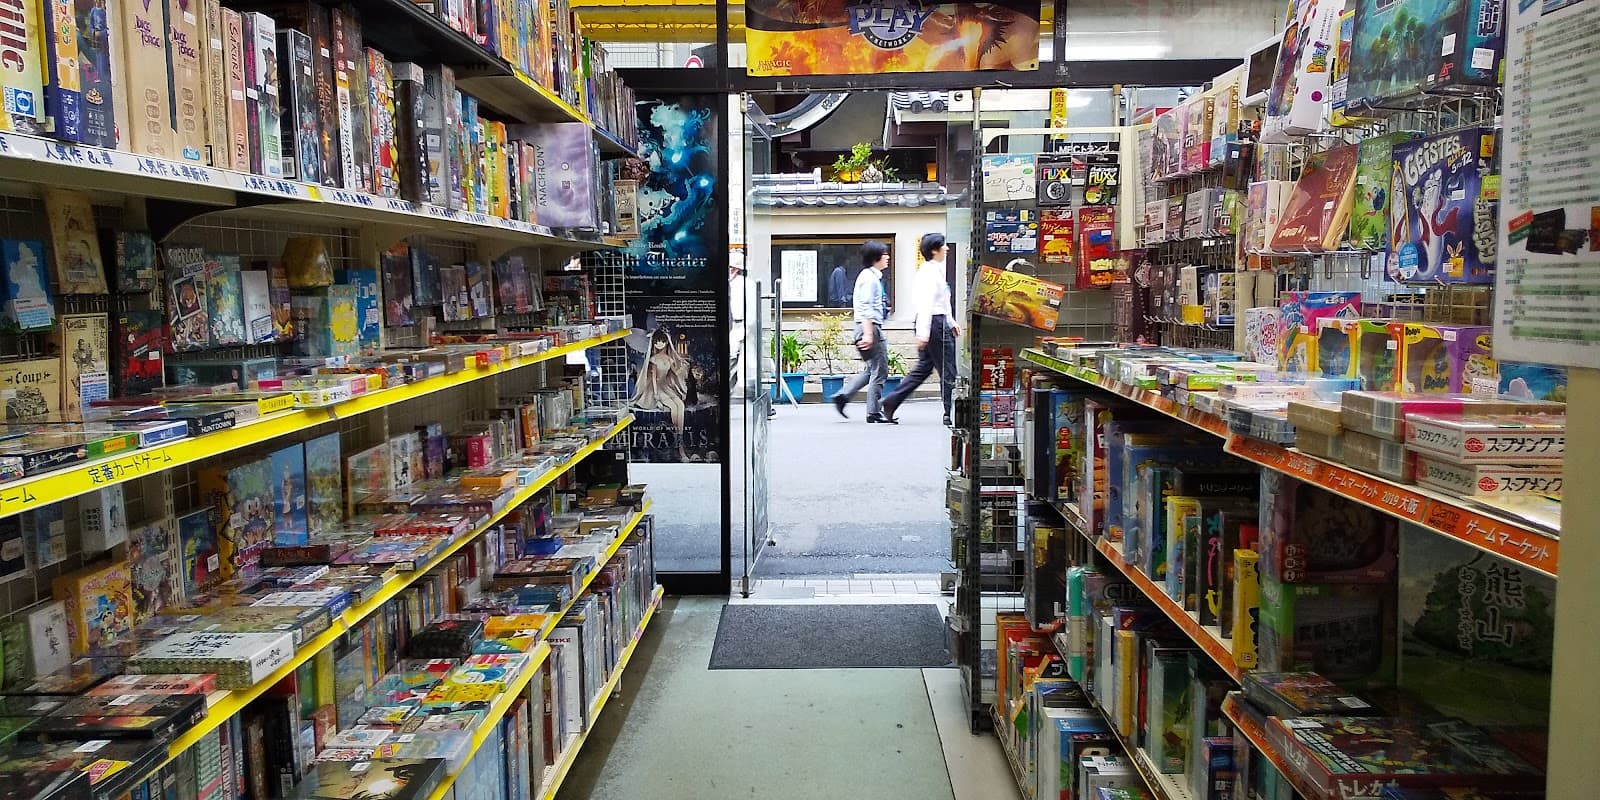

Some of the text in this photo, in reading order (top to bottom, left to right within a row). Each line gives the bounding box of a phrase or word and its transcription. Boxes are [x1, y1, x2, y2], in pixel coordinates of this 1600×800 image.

[848, 4, 940, 35] PLAY
[229, 22, 241, 81] SAKURA
[874, 37, 908, 48] NETWORK
[44, 141, 84, 165] 人気作
[87, 150, 101, 165] &
[1451, 163, 1458, 174] 5
[1461, 151, 1473, 168] 12
[137, 157, 211, 183] 人気作 & 準新作
[536, 144, 547, 207] ANACHRONY
[1043, 167, 1070, 181] FLUXX
[1089, 171, 1117, 185] FLUXX
[243, 175, 267, 192] 人気作
[167, 247, 204, 268] SHERLOCK
[645, 250, 708, 272] Theater
[982, 268, 1021, 296] カタン
[15, 371, 42, 385] Coup
[87, 449, 172, 485] 定番カードゲーム
[1287, 456, 1302, 471] 2019
[1301, 459, 1316, 476] 大阪
[0, 487, 37, 510] ーム
[1327, 469, 1420, 515] ゲームマーケット 2019 大阪
[1465, 518, 1550, 562] ゲームマーケット
